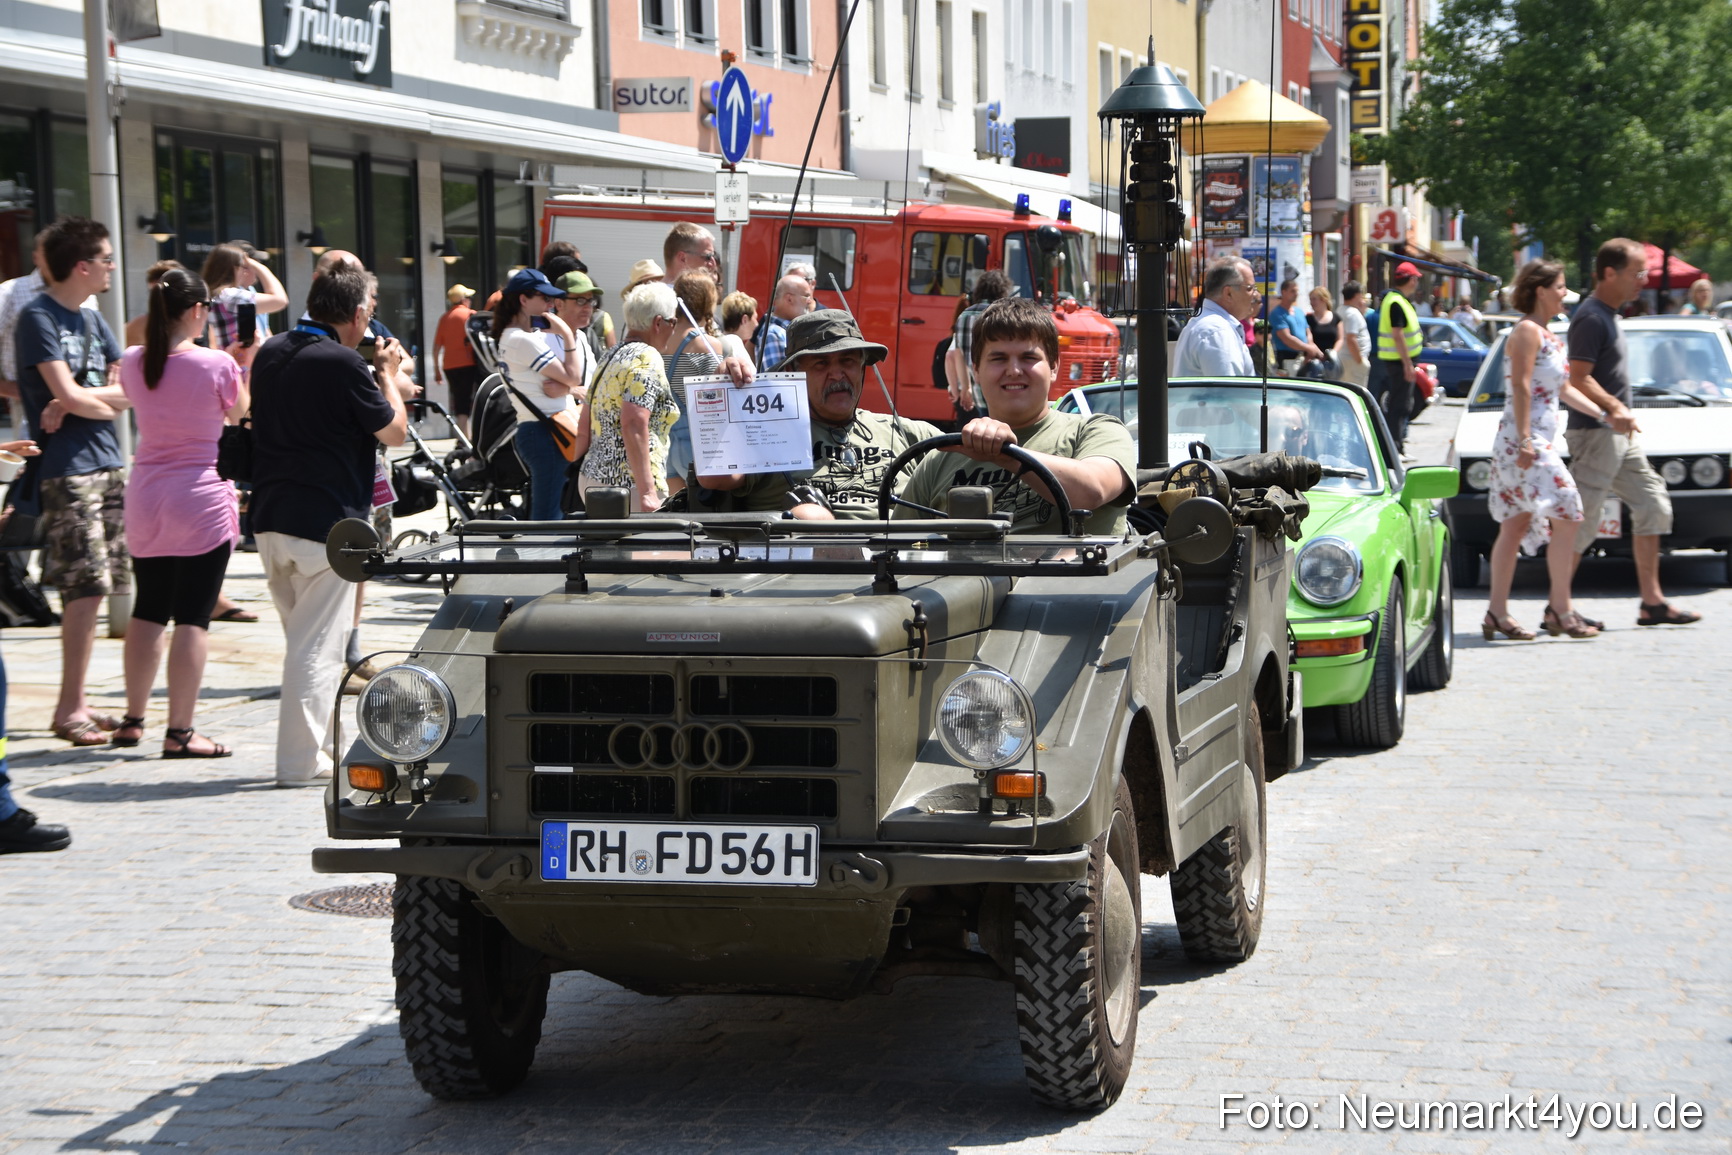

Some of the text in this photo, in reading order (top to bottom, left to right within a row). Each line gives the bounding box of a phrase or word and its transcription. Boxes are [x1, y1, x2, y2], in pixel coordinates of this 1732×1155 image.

[616, 83, 688, 106] sutor.
[742, 393, 784, 414] 494
[570, 829, 626, 873] RH
[550, 856, 558, 869] D
